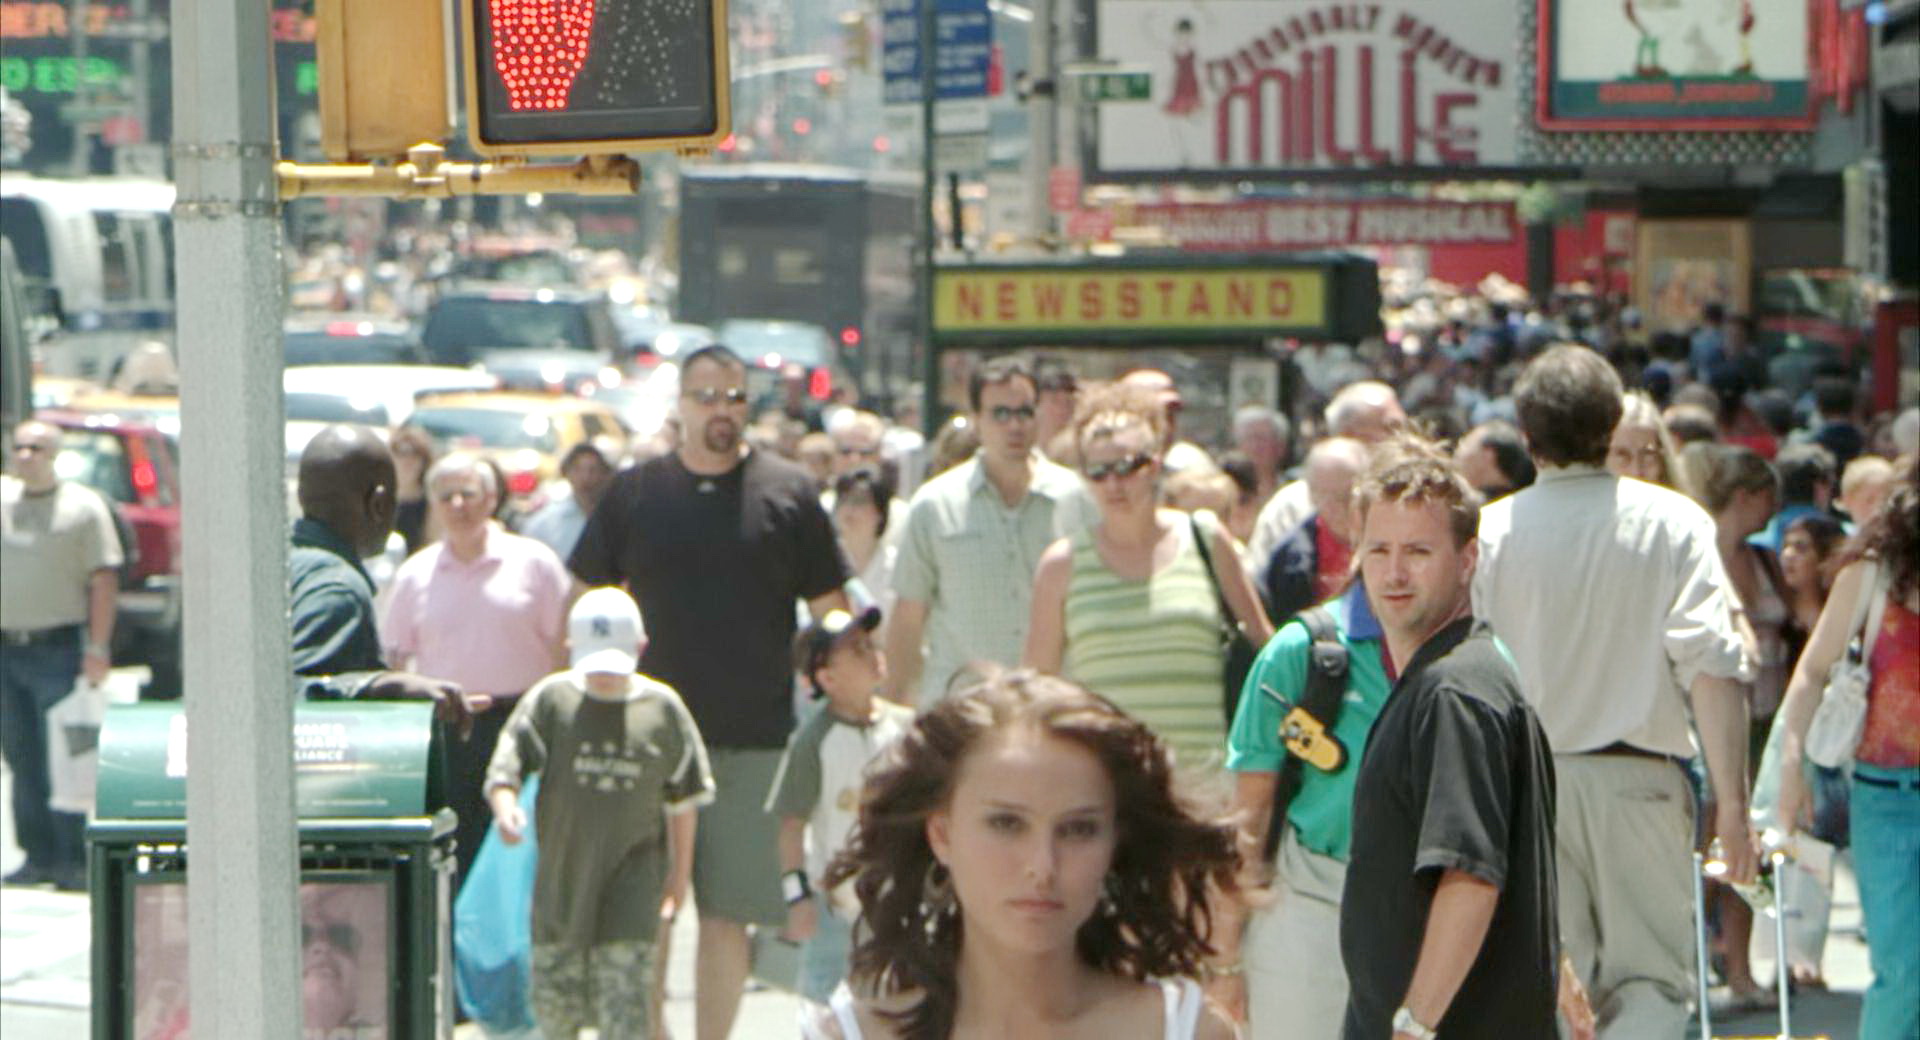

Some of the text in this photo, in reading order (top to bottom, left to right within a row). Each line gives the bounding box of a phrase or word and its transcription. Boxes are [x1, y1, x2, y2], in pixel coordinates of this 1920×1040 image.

[1267, 206, 1351, 242] BEST
[1358, 206, 1513, 241] MUSICAL
[957, 280, 1294, 321] NEWSSTAND
